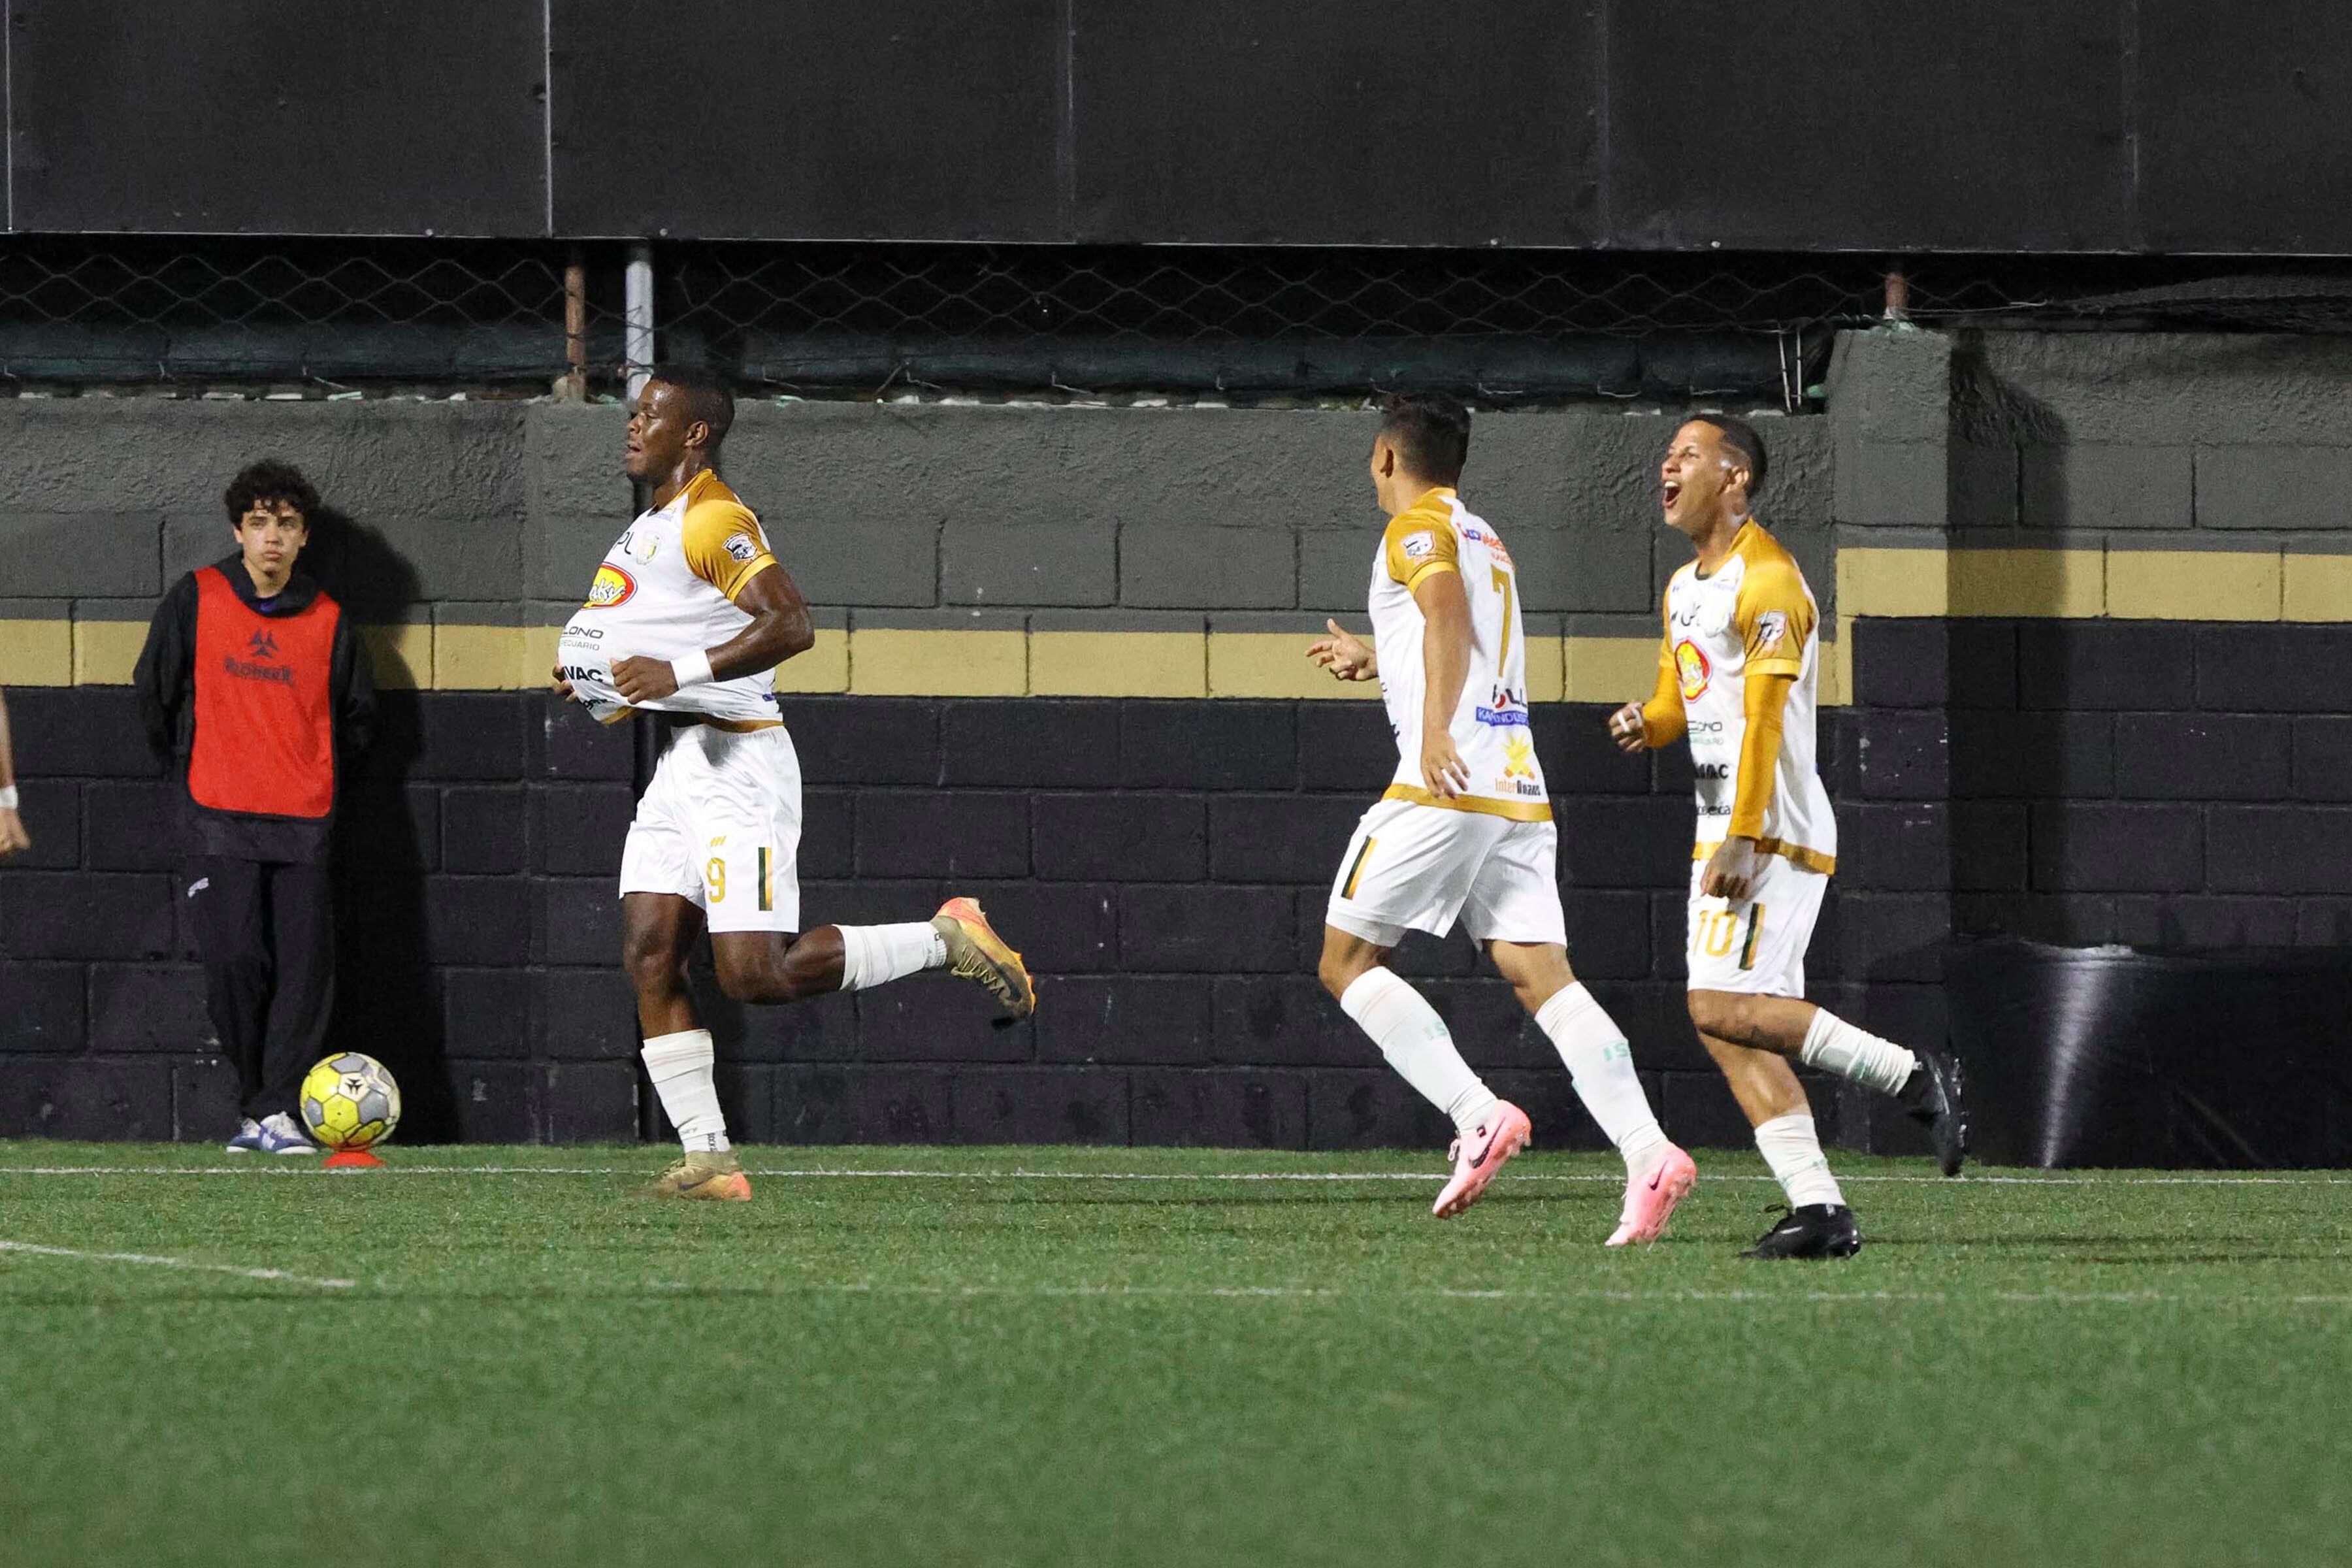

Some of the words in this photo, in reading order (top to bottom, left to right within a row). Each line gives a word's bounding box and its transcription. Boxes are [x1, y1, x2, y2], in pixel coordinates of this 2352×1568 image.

[1490, 564, 1512, 678] 7
[706, 857, 726, 904] 9
[1693, 909, 1739, 957] 10
